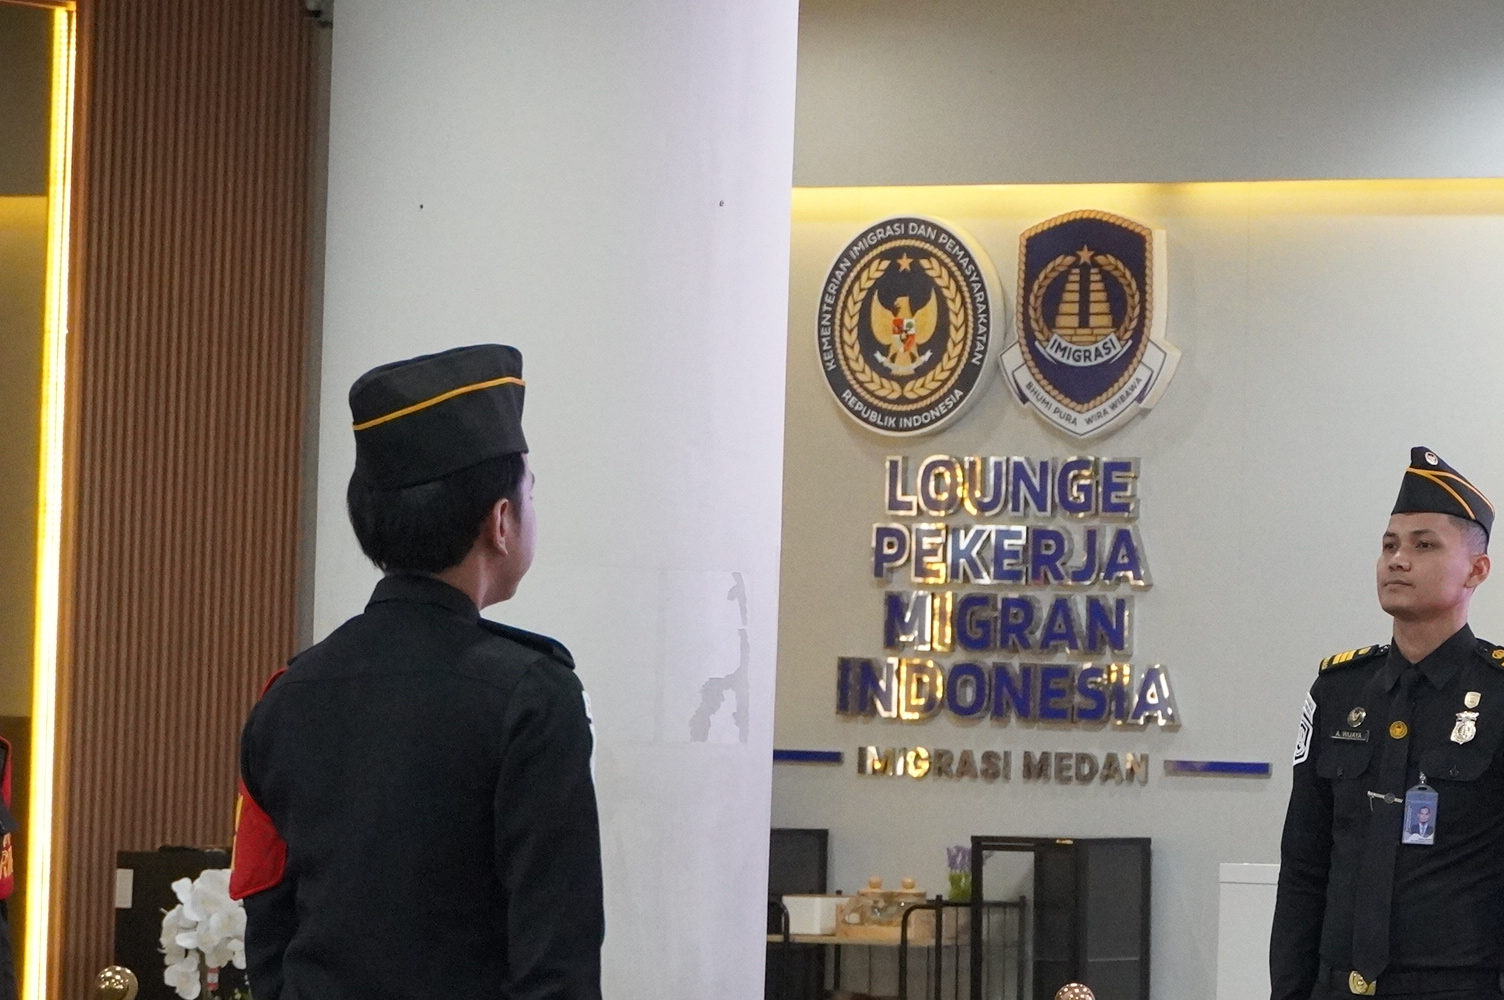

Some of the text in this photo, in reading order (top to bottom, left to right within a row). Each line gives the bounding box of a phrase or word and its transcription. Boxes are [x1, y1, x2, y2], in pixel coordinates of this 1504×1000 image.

[821, 222, 990, 371] KEMENTERIAN IMIGRASI DAN PEMASYARAKATAN
[1050, 338, 1117, 363] IMIGRASI
[842, 388, 963, 428] REPUBLIK INDONESIA
[1025, 381, 1051, 411] BHUMI
[1053, 406, 1078, 426] PURA
[1085, 408, 1109, 425] WIRA
[884, 455, 1141, 518] LOUNGE
[872, 523, 1152, 587] PEKERJA
[883, 590, 1134, 655] MIGRAN
[836, 657, 1181, 729] INDONESIA
[857, 745, 1150, 785] IMIGRASI MEDAN
